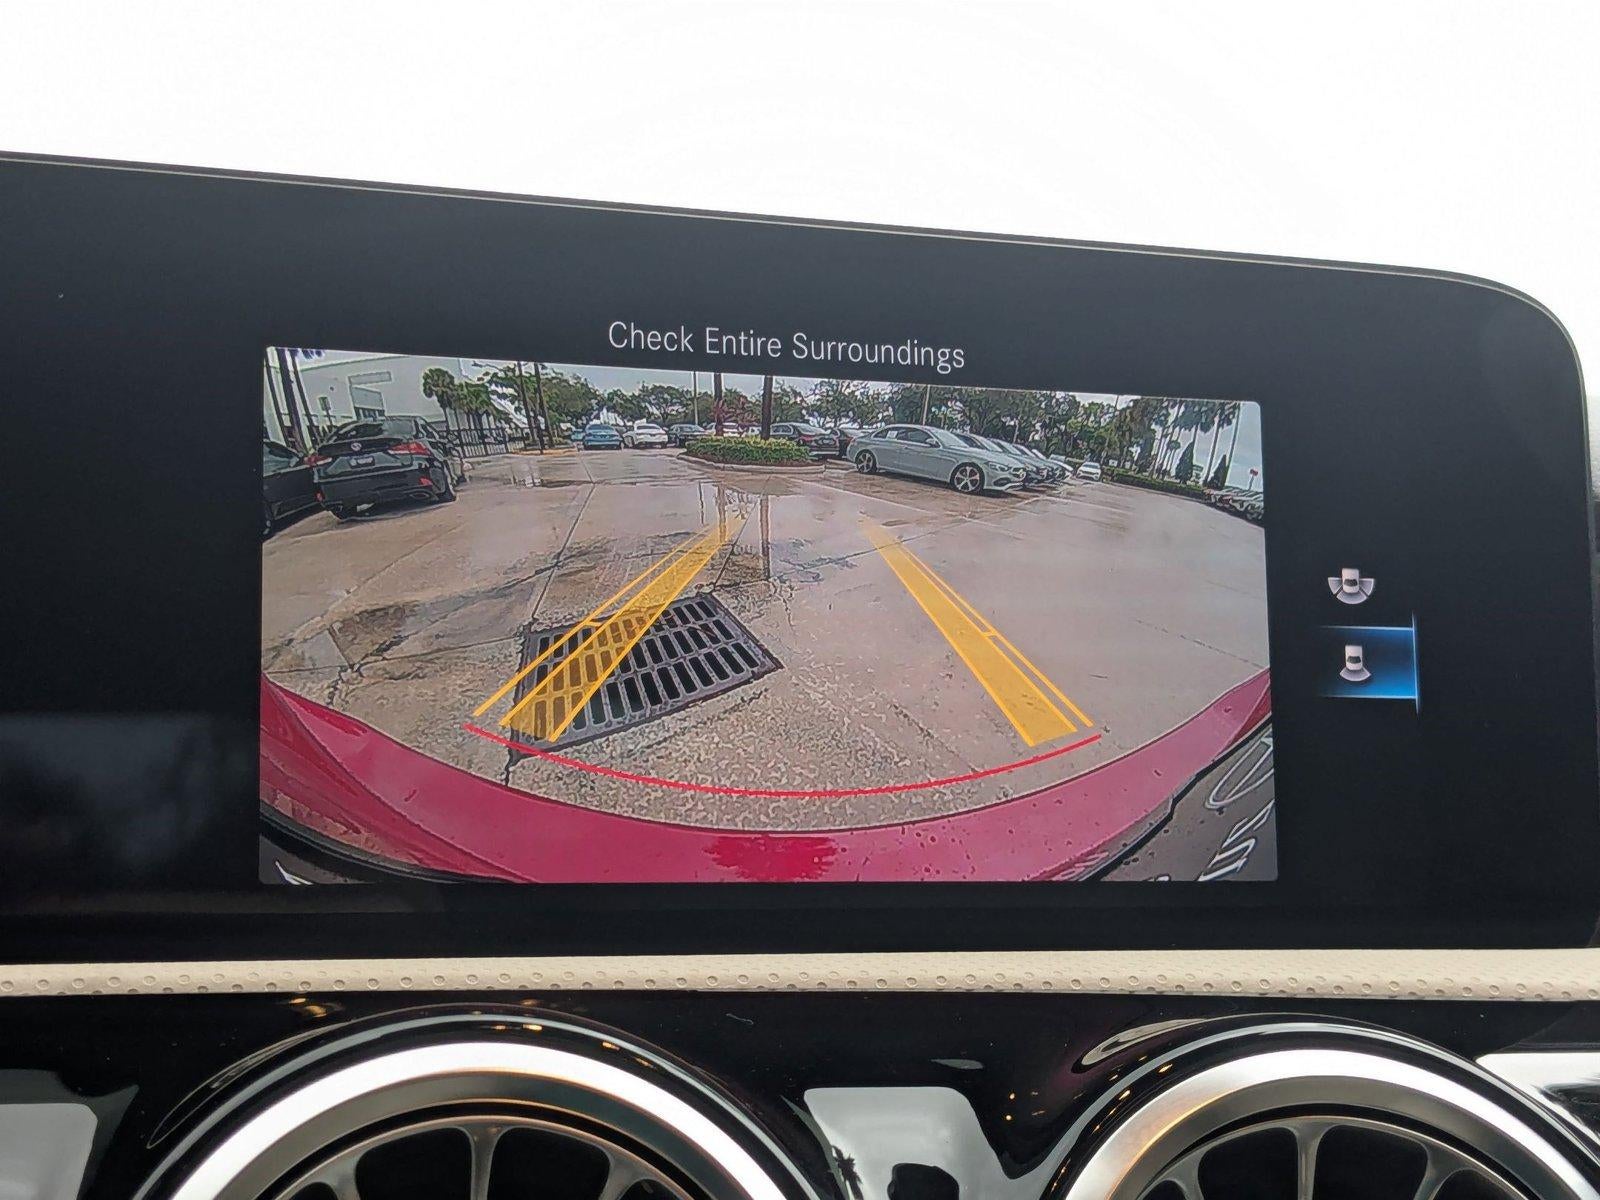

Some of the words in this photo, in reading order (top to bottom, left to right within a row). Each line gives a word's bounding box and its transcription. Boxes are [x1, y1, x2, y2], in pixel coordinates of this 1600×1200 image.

[608, 320, 694, 353] Check
[705, 326, 782, 358] Entire
[792, 332, 965, 375] Surroundings
